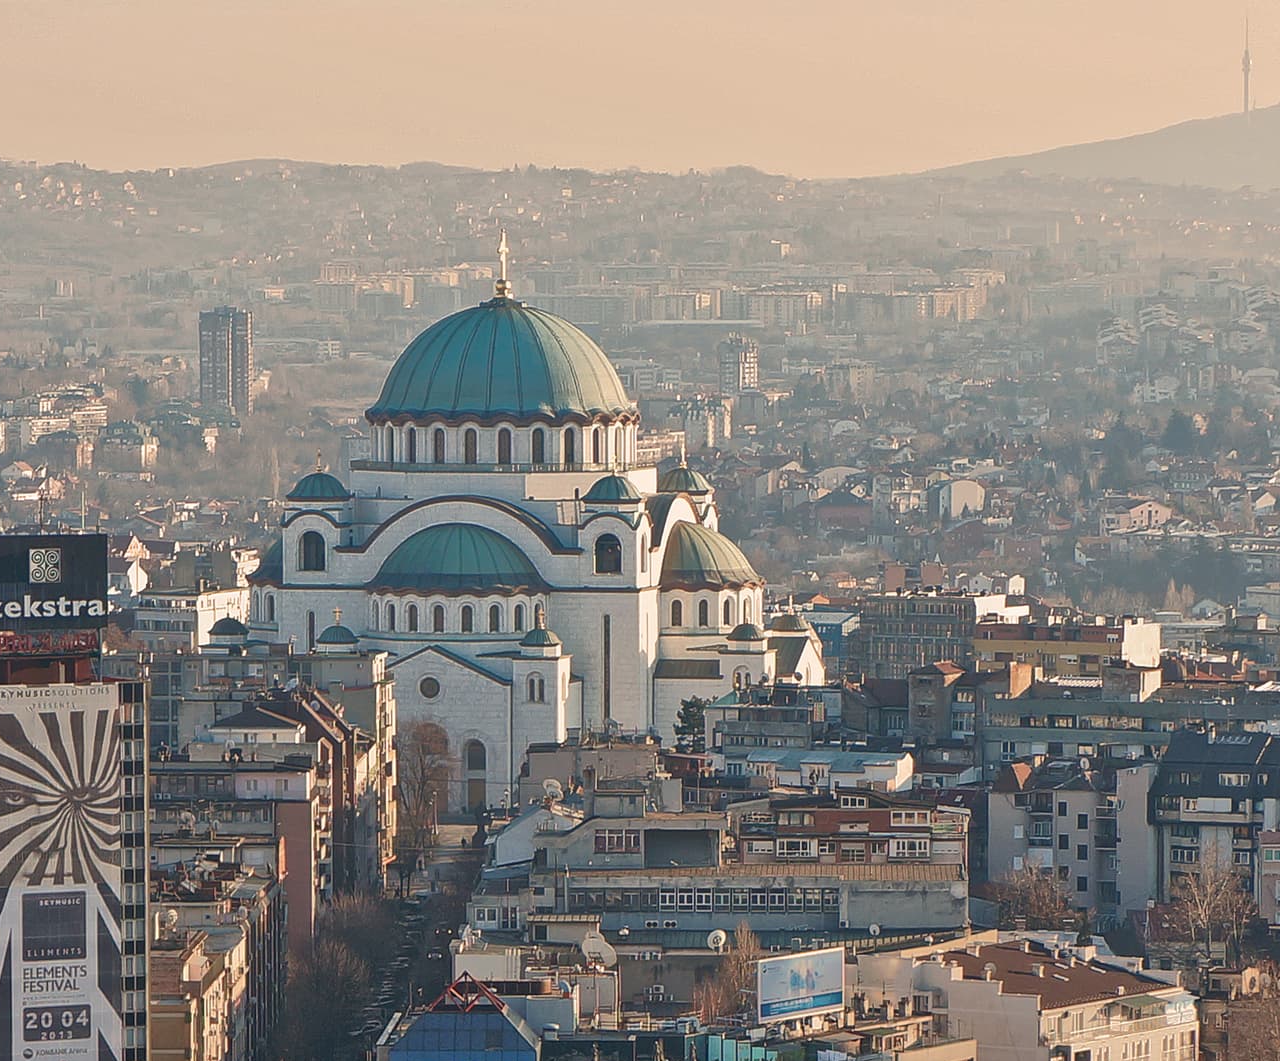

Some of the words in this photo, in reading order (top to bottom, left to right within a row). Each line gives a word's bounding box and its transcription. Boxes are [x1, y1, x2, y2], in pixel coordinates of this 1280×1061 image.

[23, 965, 87, 980] ELEMENTS
[23, 979, 81, 993] FESTIVAL
[25, 1011, 53, 1029] 20
[61, 1009, 89, 1027] 04
[40, 1030, 73, 1040] 2013
